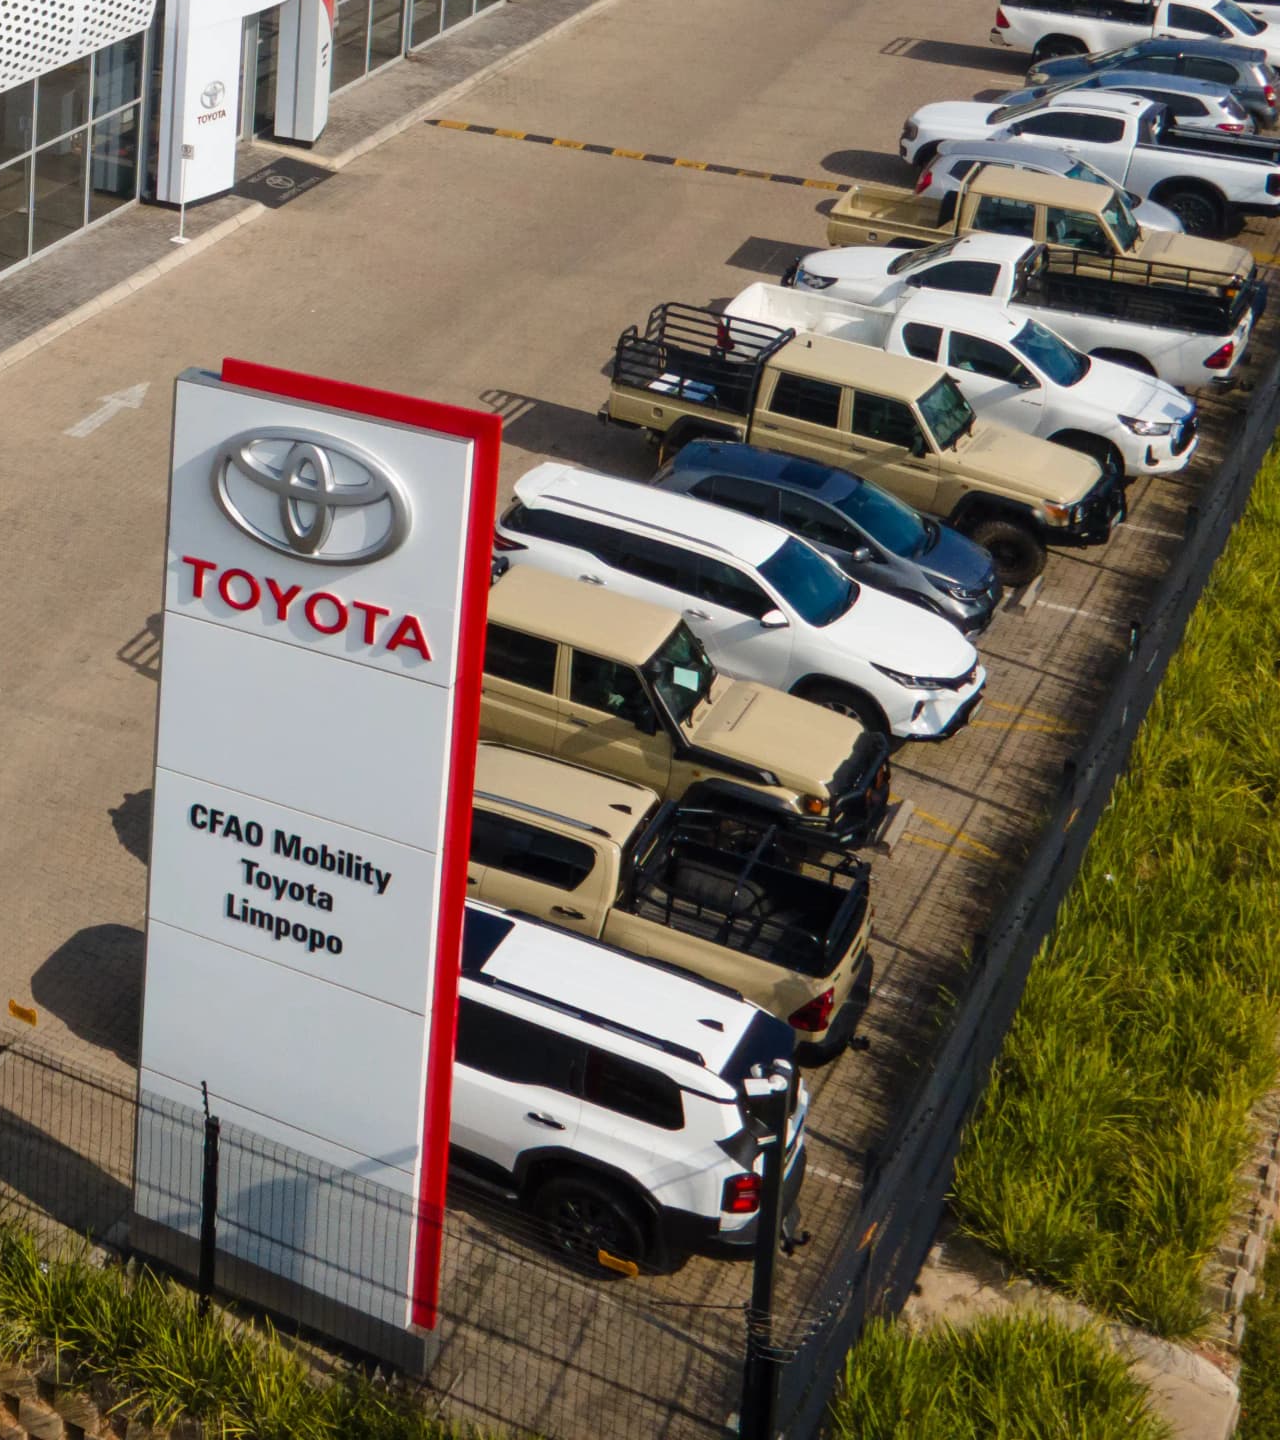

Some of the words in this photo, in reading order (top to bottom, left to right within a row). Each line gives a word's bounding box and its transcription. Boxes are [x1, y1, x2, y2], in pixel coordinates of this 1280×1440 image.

[197, 109, 226, 125] TOYOTA
[182, 556, 433, 662] TOYOTA
[189, 803, 264, 848] CFAO
[273, 829, 392, 895] Mobility
[240, 857, 334, 912] Toyota
[225, 892, 344, 955] Limpopo
